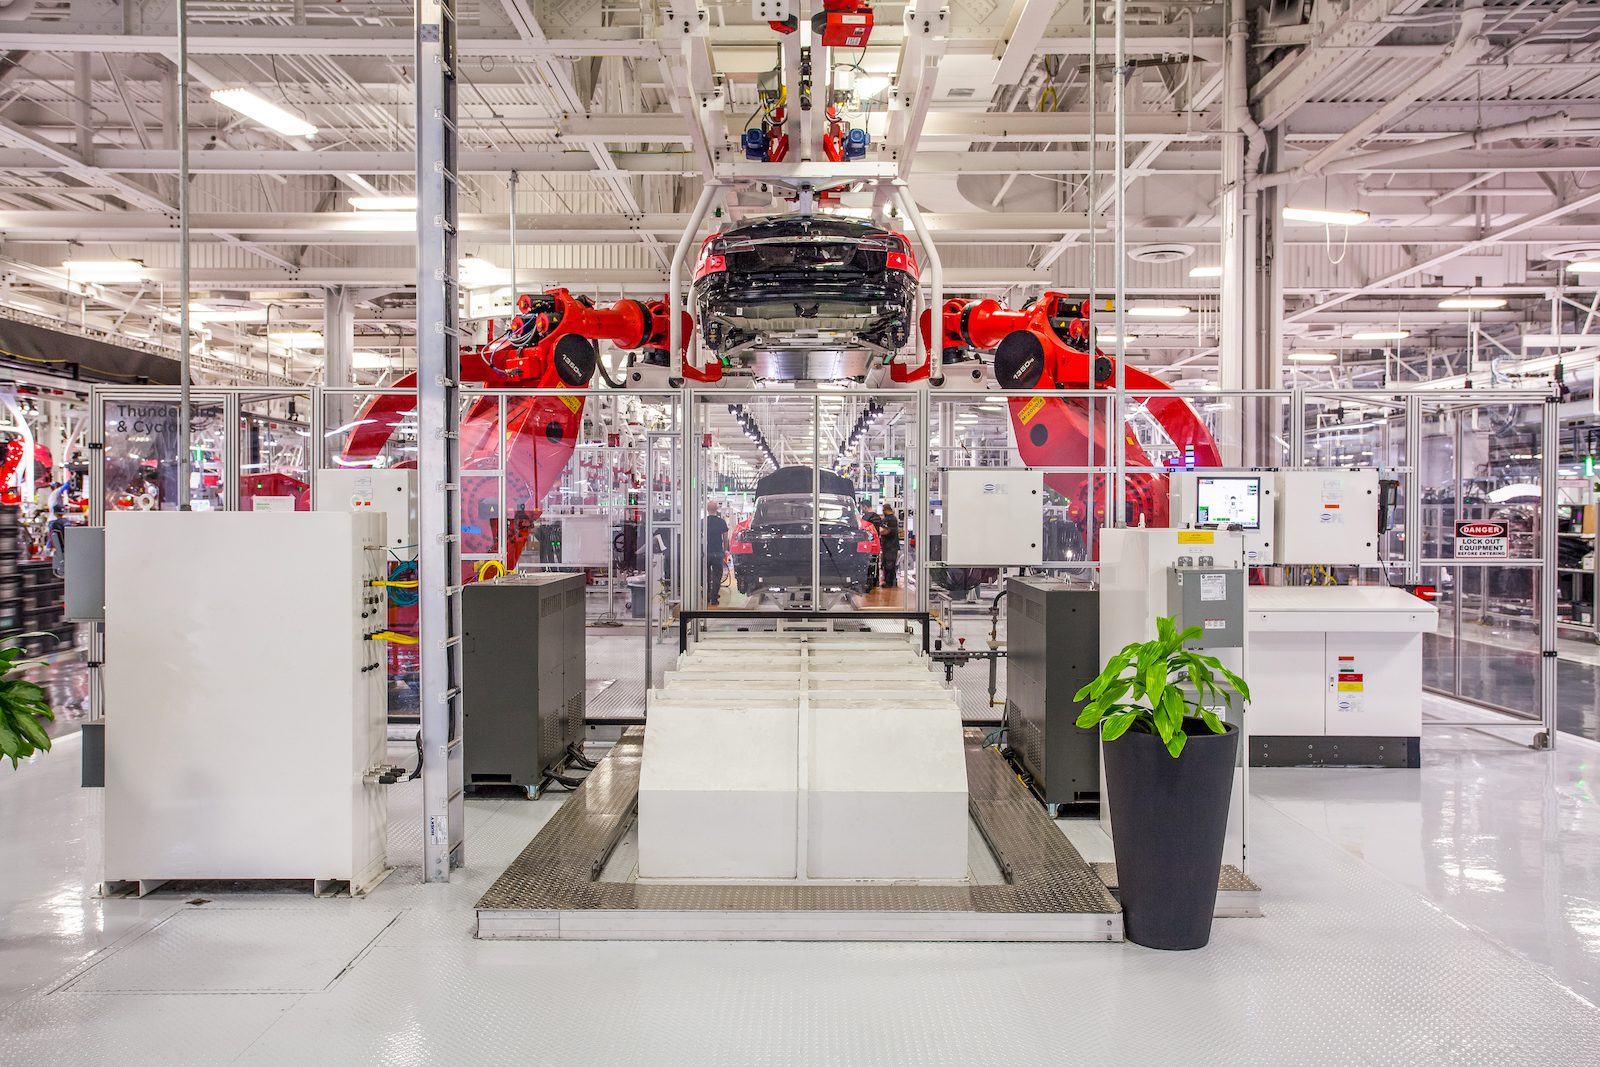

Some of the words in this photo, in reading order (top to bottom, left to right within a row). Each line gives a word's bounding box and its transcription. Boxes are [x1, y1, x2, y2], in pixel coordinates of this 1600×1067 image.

[117, 404, 217, 417] Thundeird
[117, 420, 128, 433] &
[133, 420, 197, 435] Cyclos
